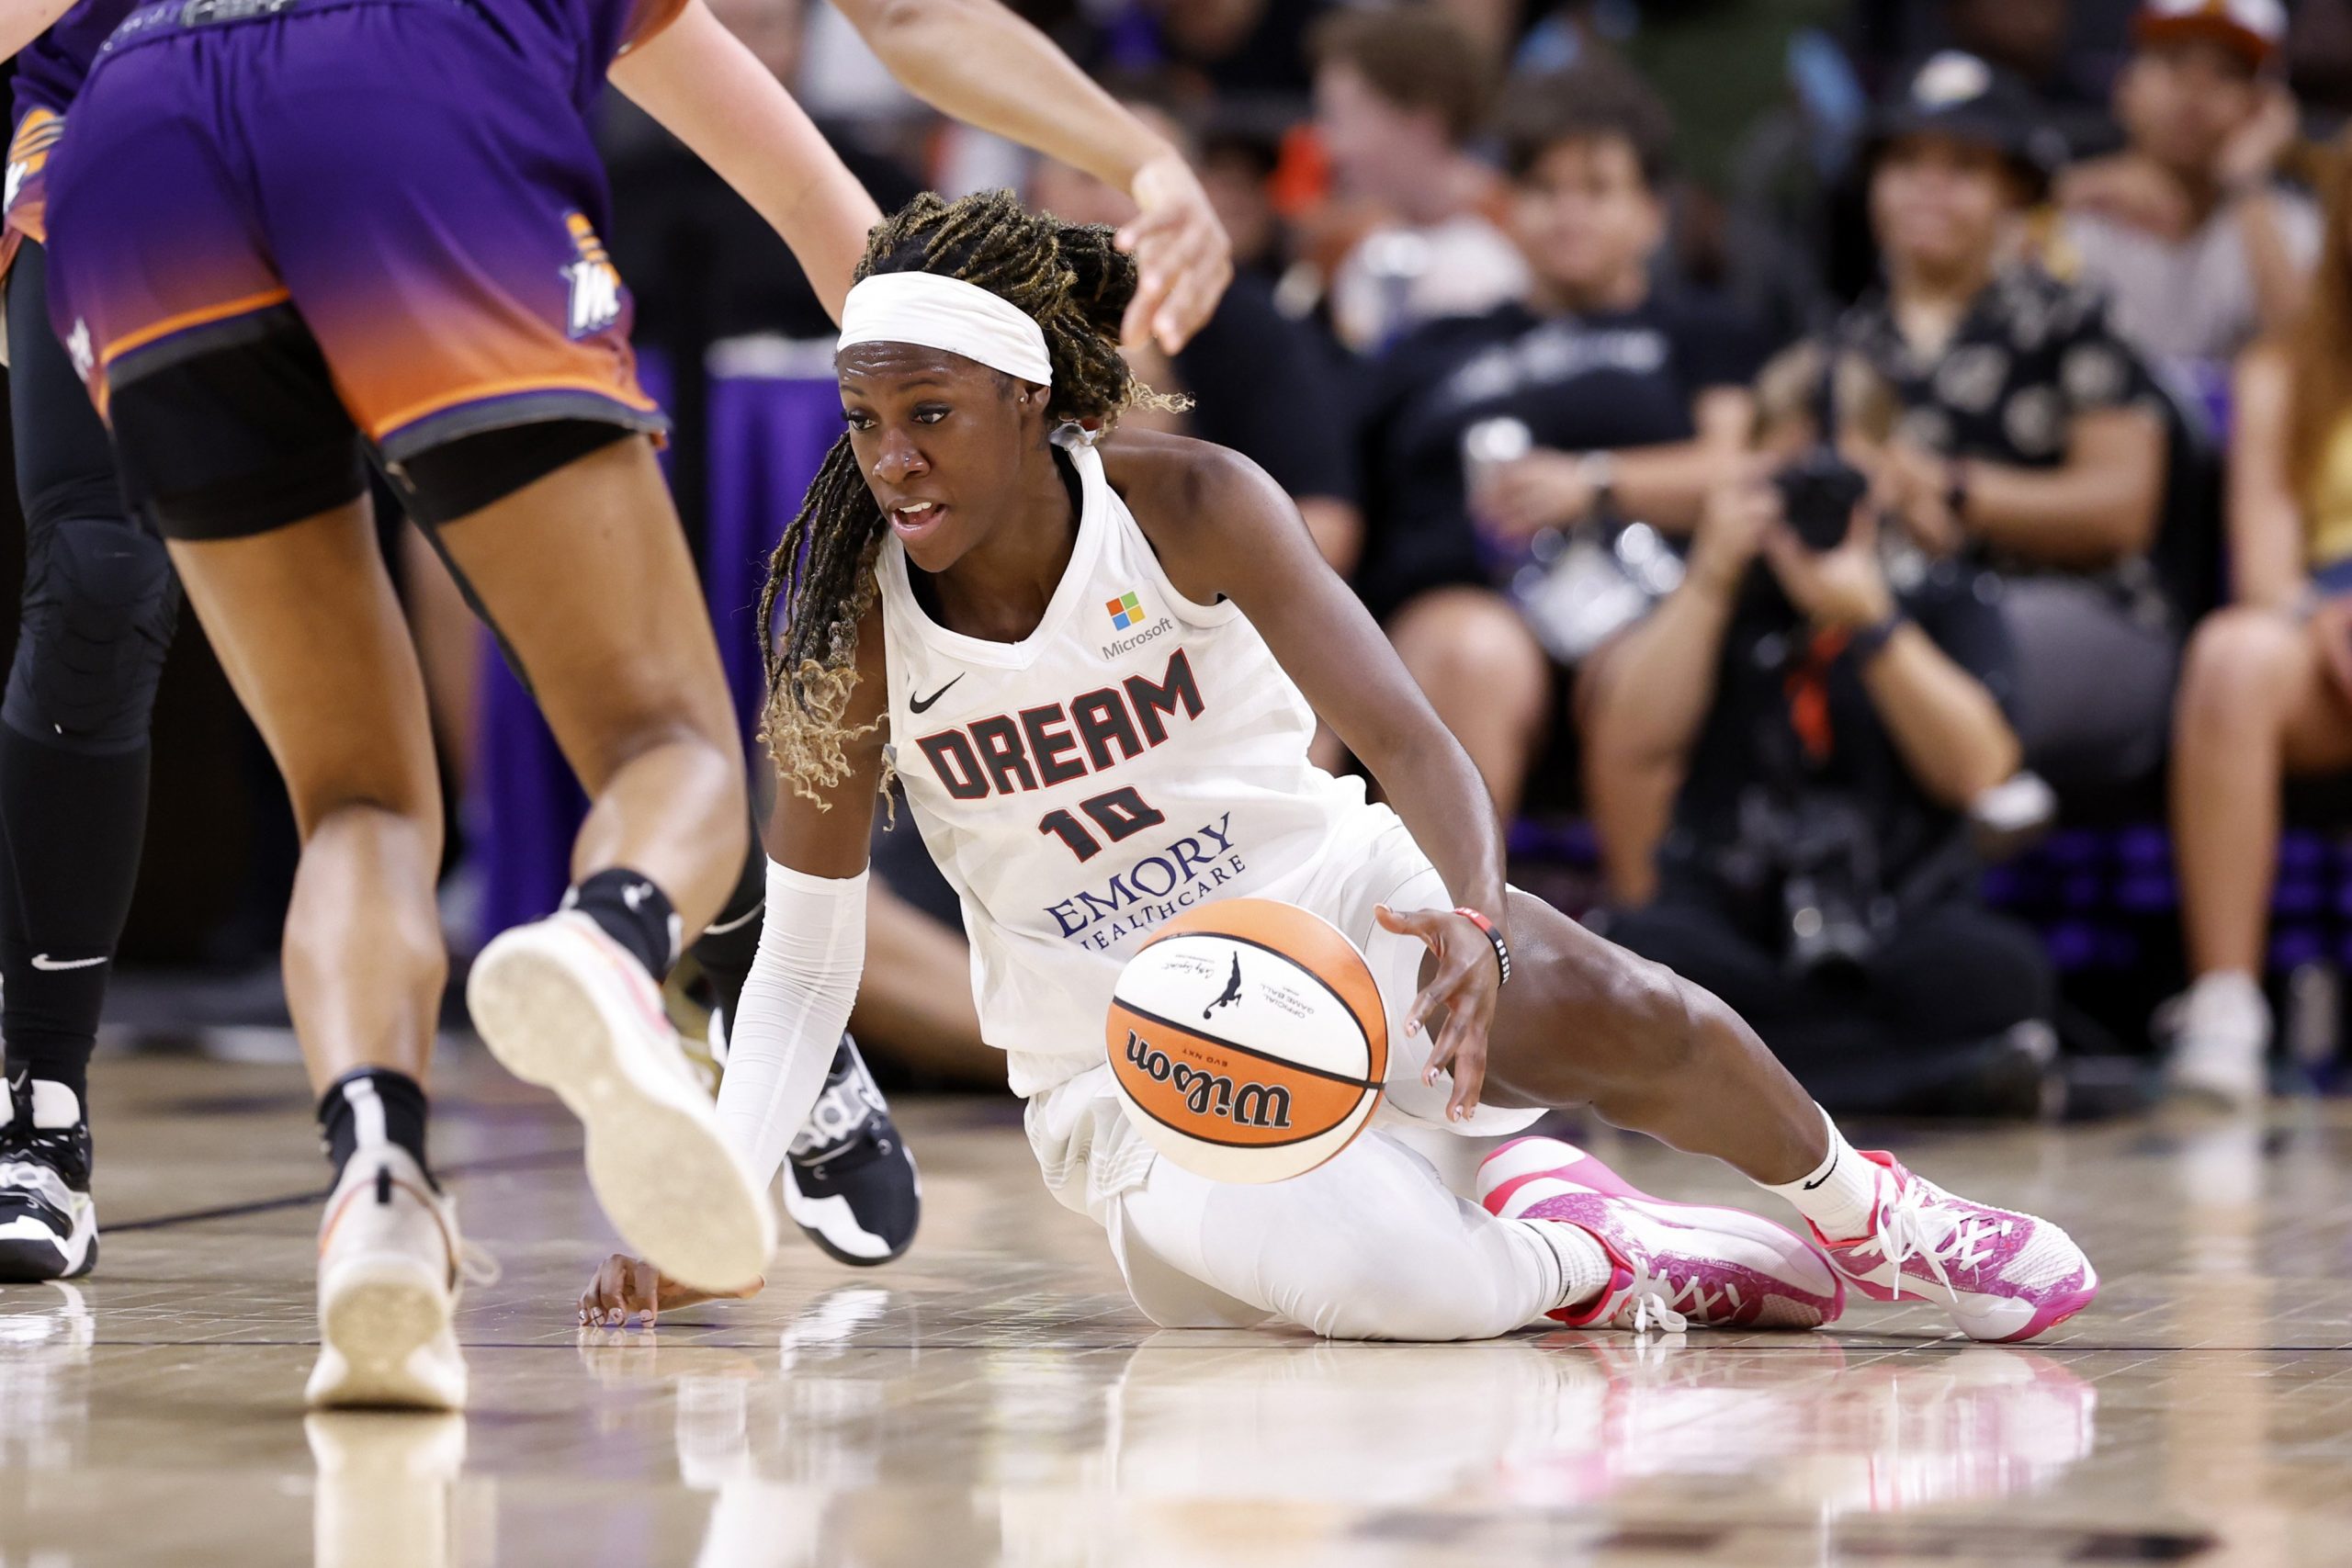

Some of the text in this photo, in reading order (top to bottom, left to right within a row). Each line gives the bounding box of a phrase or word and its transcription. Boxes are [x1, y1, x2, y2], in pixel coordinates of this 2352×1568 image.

[1102, 617, 1173, 660] Microsoft
[916, 647, 1205, 800] DREAM
[1037, 784, 1166, 863] 10
[1043, 811, 1236, 939] EMORY
[1260, 983, 1285, 999] BALL
[1263, 993, 1306, 1019] OFFICIAL
[1287, 996, 1315, 1015] GAME
[1182, 1048, 1228, 1066] EVO NXT
[1125, 1029, 1293, 1130] Wilson
